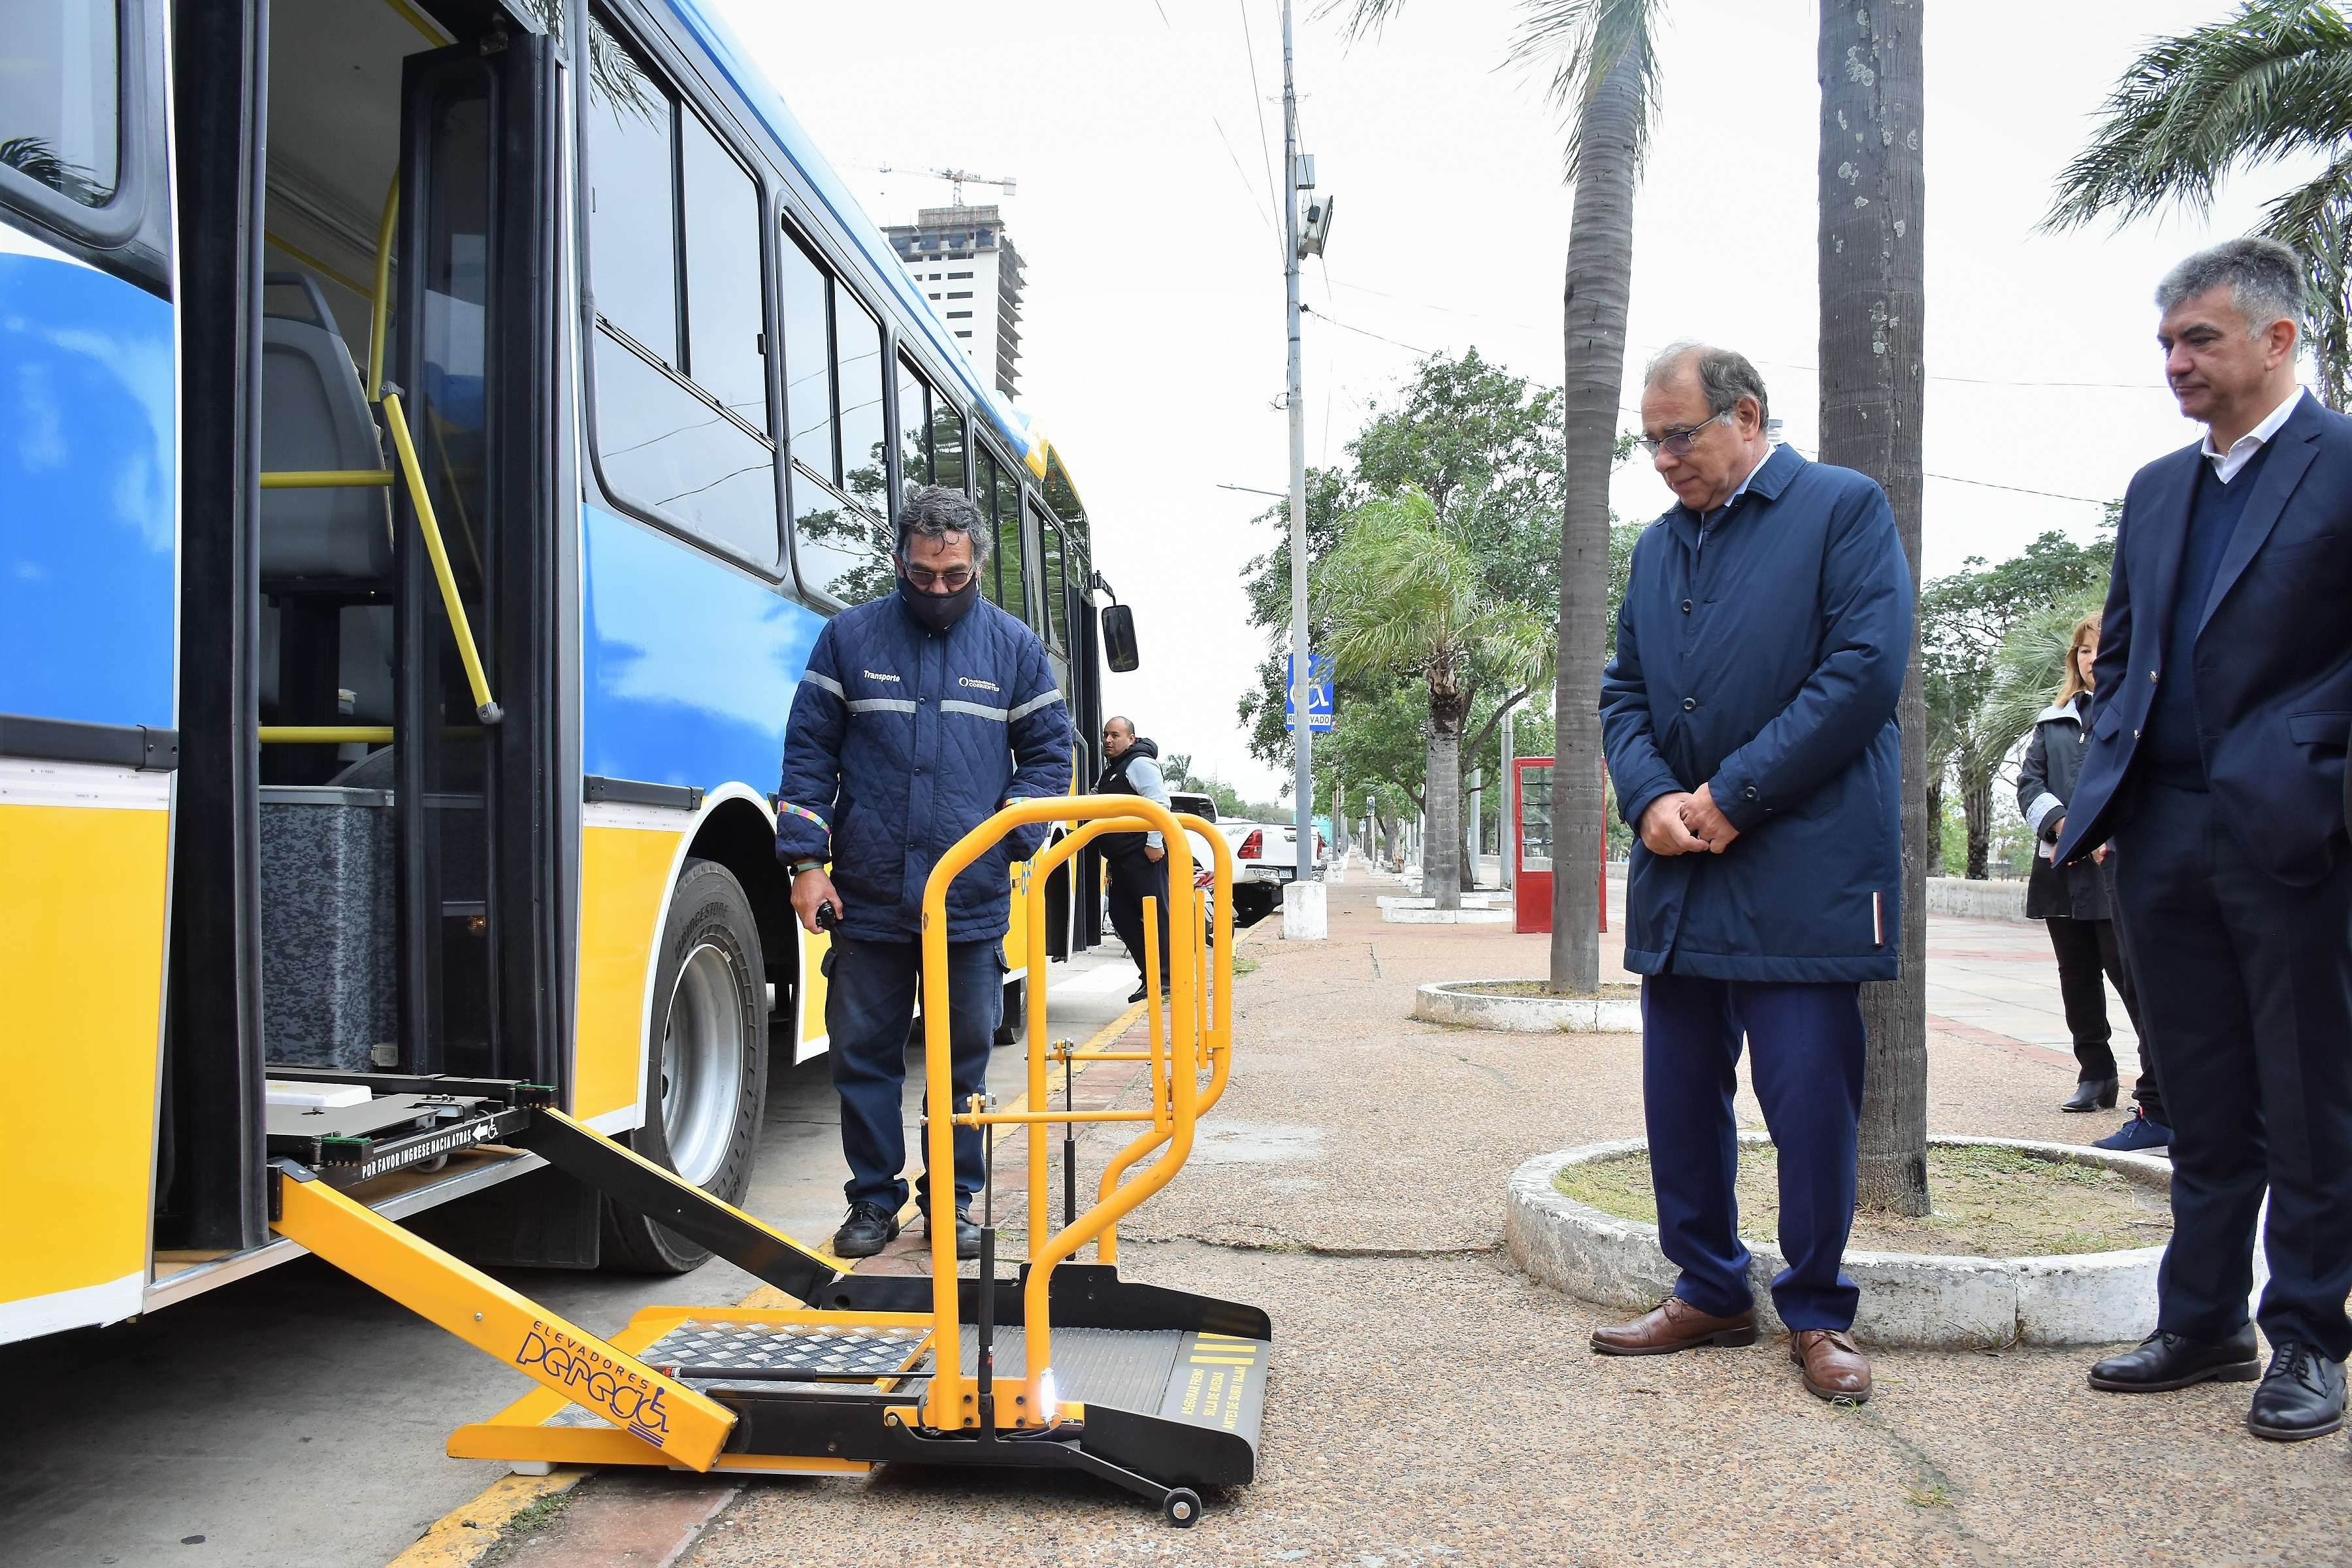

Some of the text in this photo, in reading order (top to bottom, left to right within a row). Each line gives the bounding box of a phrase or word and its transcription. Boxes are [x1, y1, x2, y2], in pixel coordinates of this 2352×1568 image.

[864, 670, 901, 682] Transporte
[969, 682, 1000, 692] CORRIENTES
[1288, 715, 1330, 724] REVADO
[676, 902, 729, 961] BRIDGESTONE
[362, 1129, 472, 1179] POR FAVOR INGRESE HACIA ATRAS
[533, 1320, 649, 1390] ELEVADORES
[1232, 1365, 1247, 1382] BAJAR
[1181, 1368, 1205, 1415] ASEGURAR FRENO
[1203, 1371, 1225, 1416] SILLA DE RUEDAS
[1228, 1384, 1243, 1401] SUBIR
[1226, 1401, 1239, 1410] DE
[1222, 1409, 1238, 1430] ANTES
